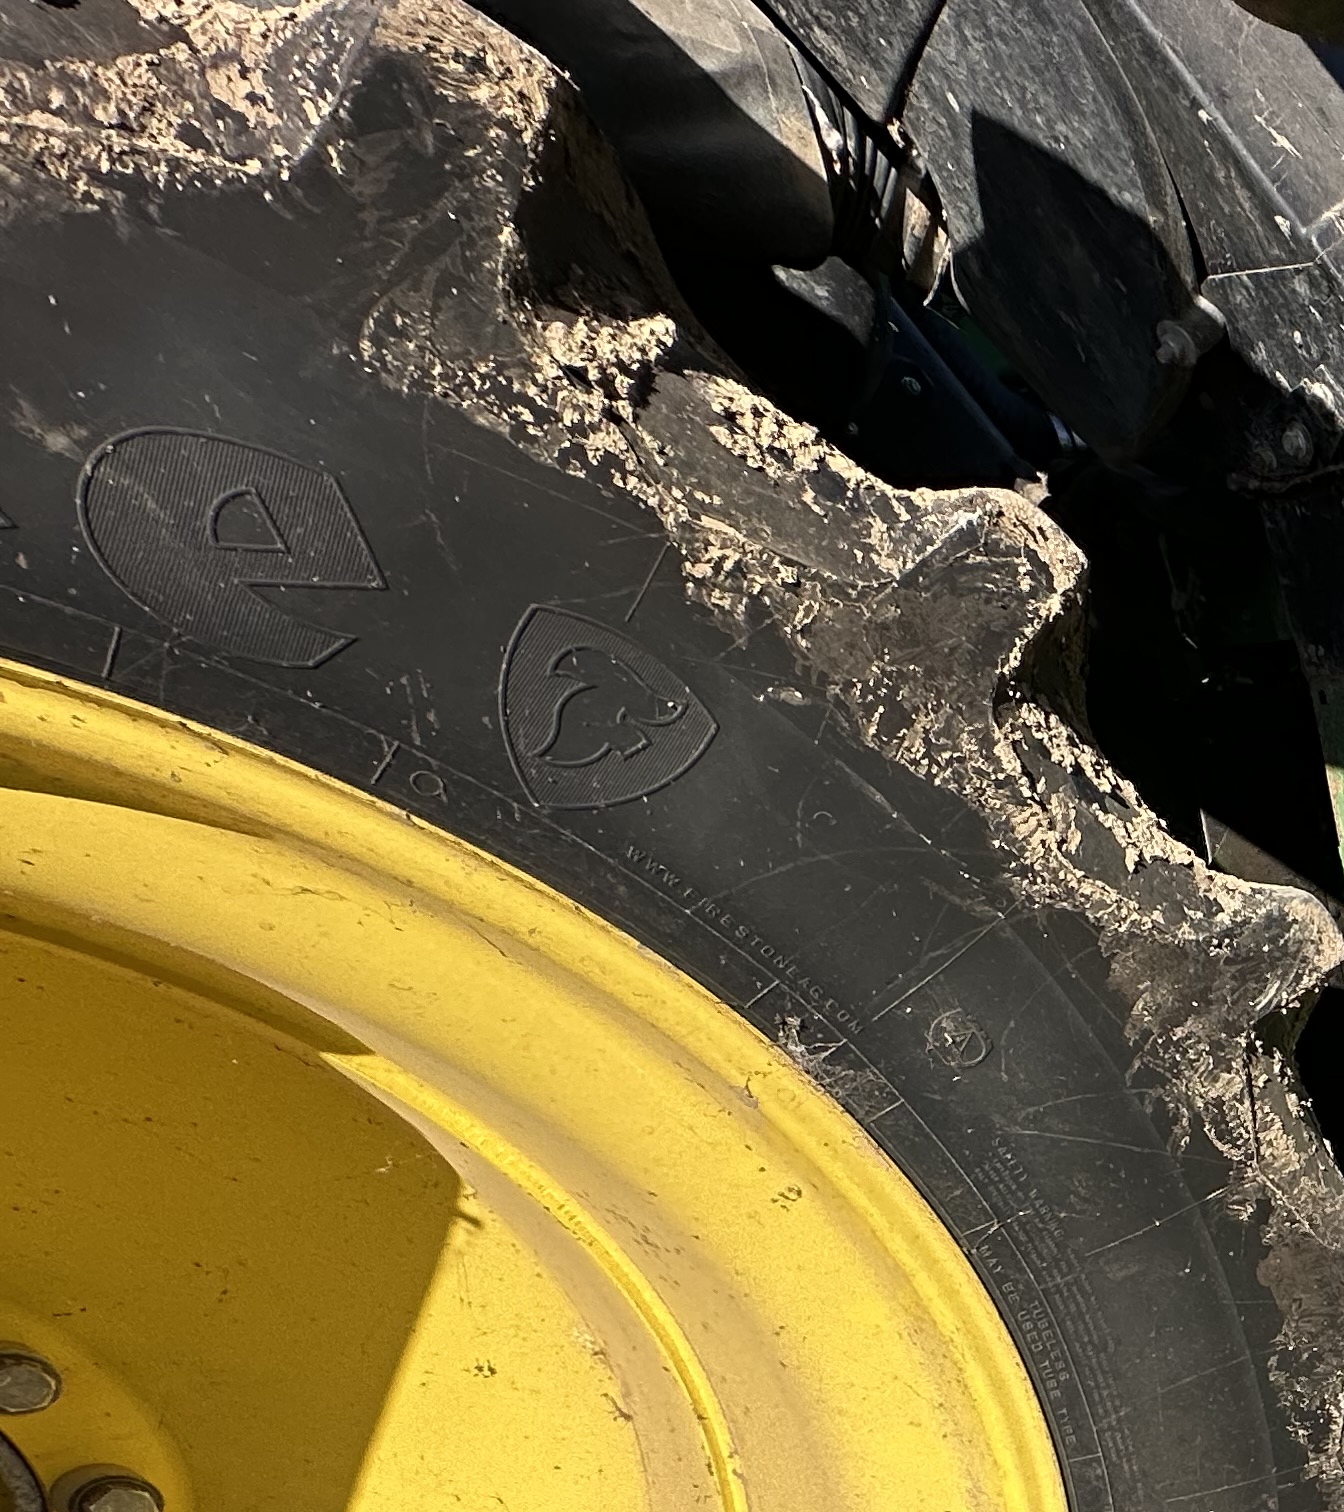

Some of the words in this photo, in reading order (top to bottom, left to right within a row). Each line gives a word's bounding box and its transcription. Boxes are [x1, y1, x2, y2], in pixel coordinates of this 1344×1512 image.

[979, 1245, 1002, 1275] MAY
[1002, 1281, 1020, 1304] BE
[1018, 1311, 1043, 1353] USED
[1037, 1358, 1062, 1400] TUBE
[1055, 1407, 1077, 1445] TYPE
[1028, 1301, 1070, 1383] TUBELESS
